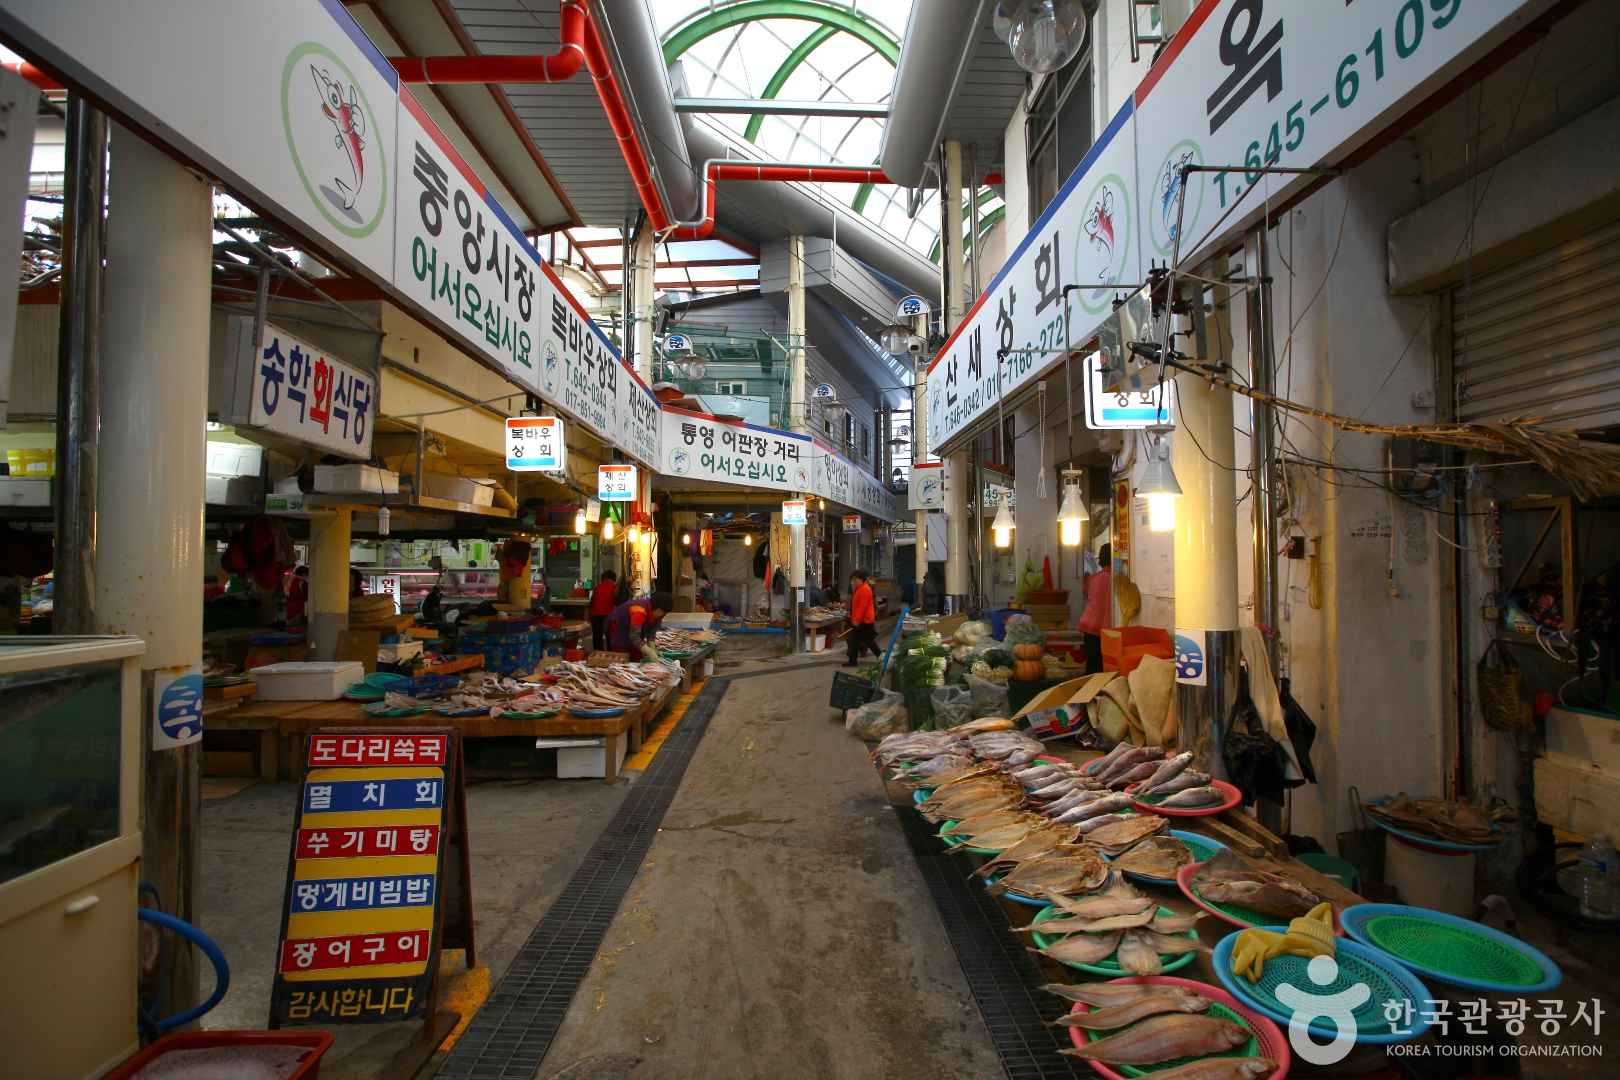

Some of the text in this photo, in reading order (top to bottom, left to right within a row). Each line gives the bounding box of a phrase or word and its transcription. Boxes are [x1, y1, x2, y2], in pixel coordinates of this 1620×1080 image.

[413, 140, 536, 322] 중앙시장
[412, 236, 532, 369] 어서오십시요
[945, 230, 1060, 407] 산새상회
[552, 293, 616, 399] 복바우상회
[260, 337, 371, 445] 송학회식당
[511, 427, 551, 441] 복바우
[680, 422, 714, 449] 통영
[722, 431, 768, 458] 어판장
[773, 440, 800, 463] 거리
[512, 444, 551, 458] 상회
[700, 453, 788, 483] 어서오십시오
[604, 483, 626, 492] 상회
[313, 739, 441, 761] 도다리쑥국
[309, 780, 438, 809] 멸치회
[307, 828, 432, 854] 쑤기미탕
[297, 878, 430, 911] 멍게비빔밥
[292, 934, 420, 968] 장어구이
[288, 987, 414, 1019] 감사합니다
